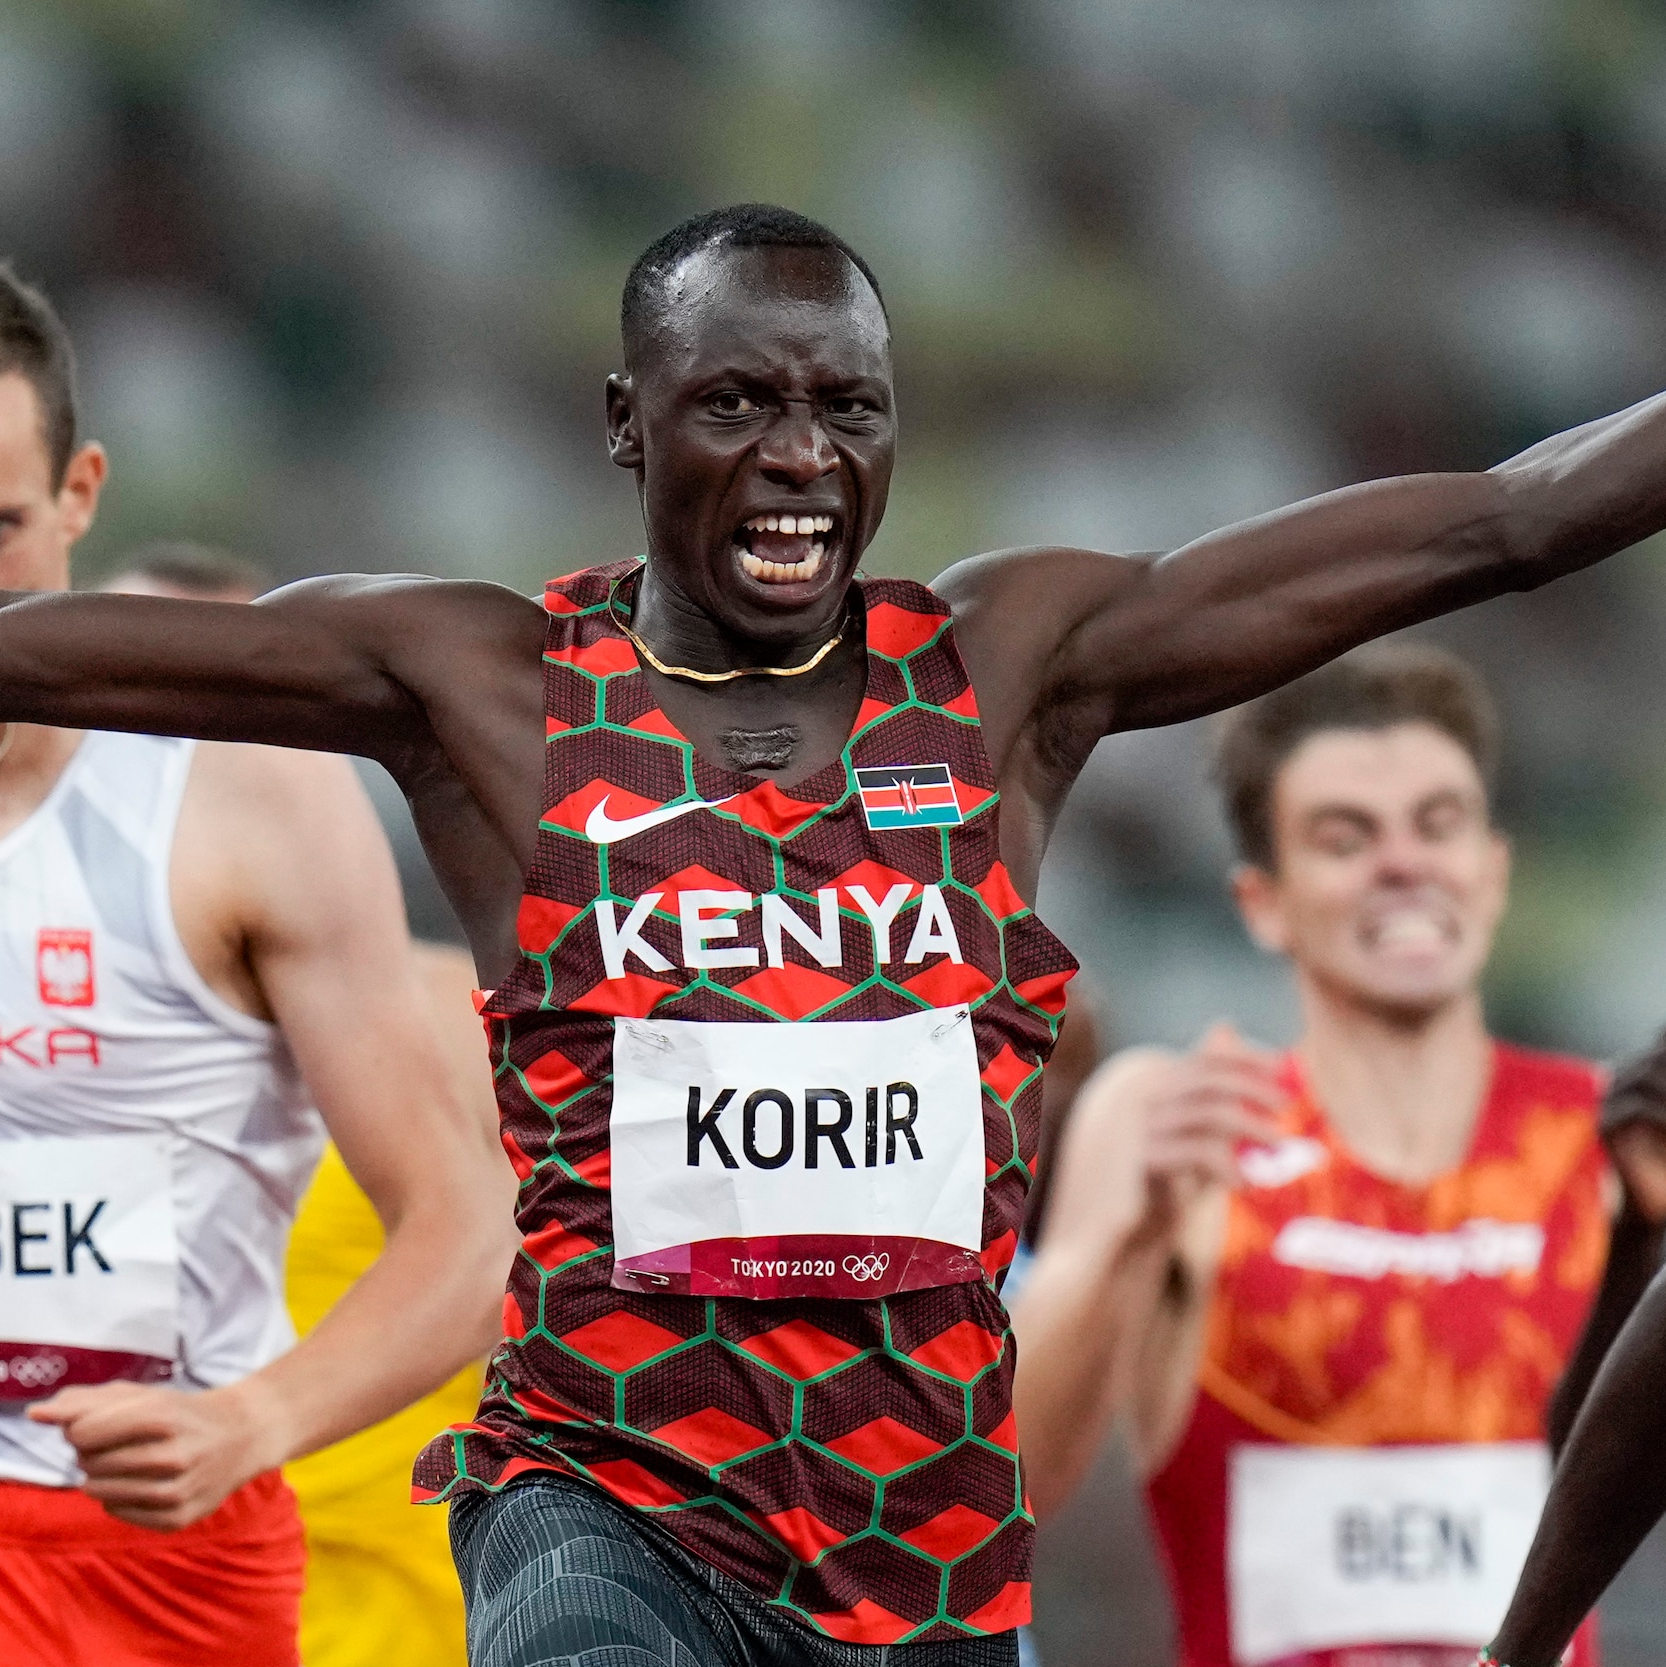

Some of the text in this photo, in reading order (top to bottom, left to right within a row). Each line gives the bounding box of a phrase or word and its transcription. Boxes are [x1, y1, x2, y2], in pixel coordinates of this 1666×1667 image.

[593, 884, 965, 979] KENYA
[685, 1082, 924, 1169] KORIR
[731, 1258, 836, 1278] TOKYO 2020
[1335, 1502, 1483, 1584] BEN
